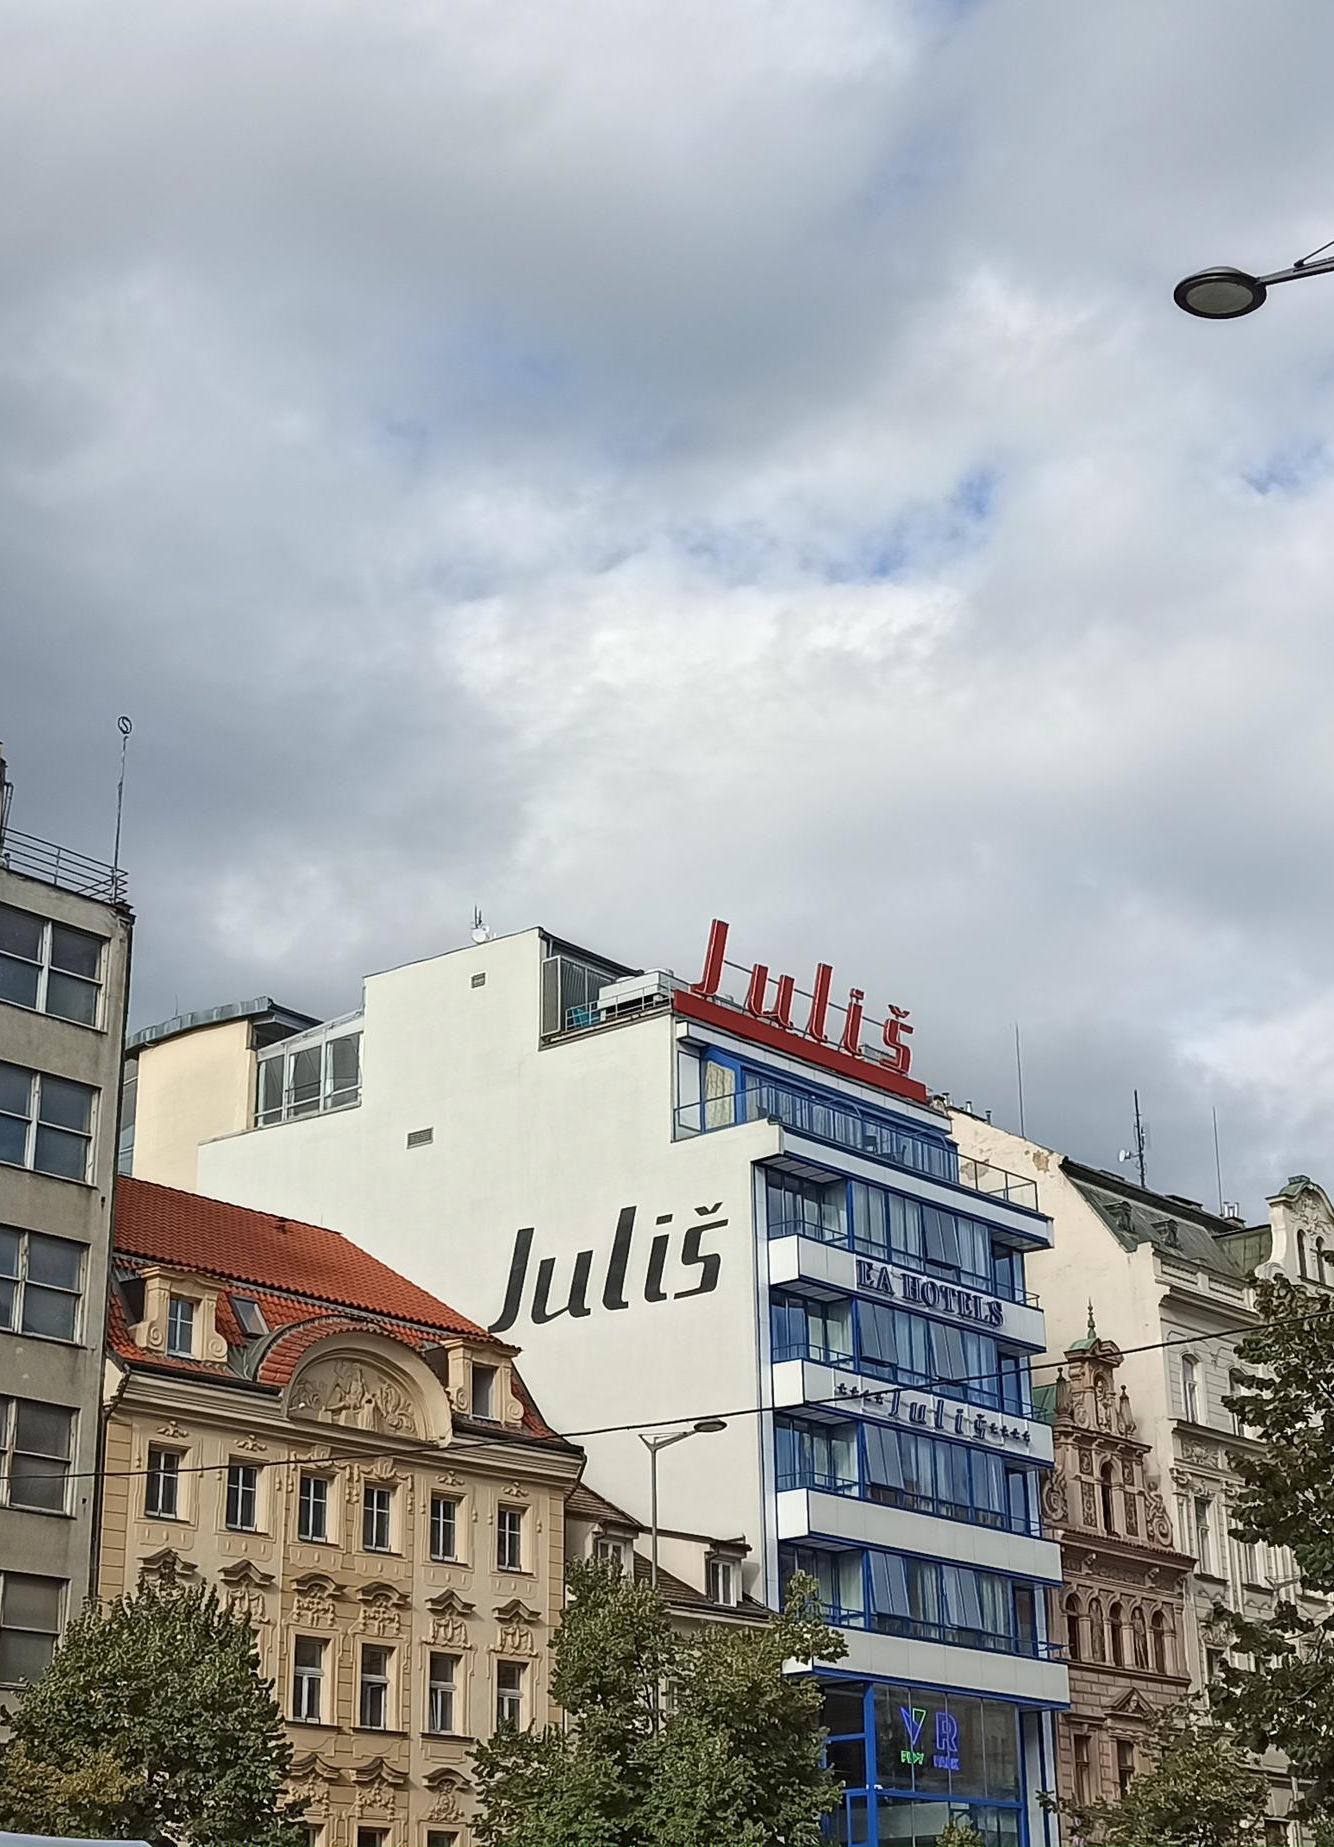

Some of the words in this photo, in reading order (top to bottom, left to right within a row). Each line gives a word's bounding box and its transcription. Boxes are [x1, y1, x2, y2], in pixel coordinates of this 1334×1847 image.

[689, 918, 914, 1074] Juliš
[487, 1201, 729, 1333] Juliš
[856, 1260, 895, 1294] EA
[901, 1273, 1005, 1327] HOTELS
